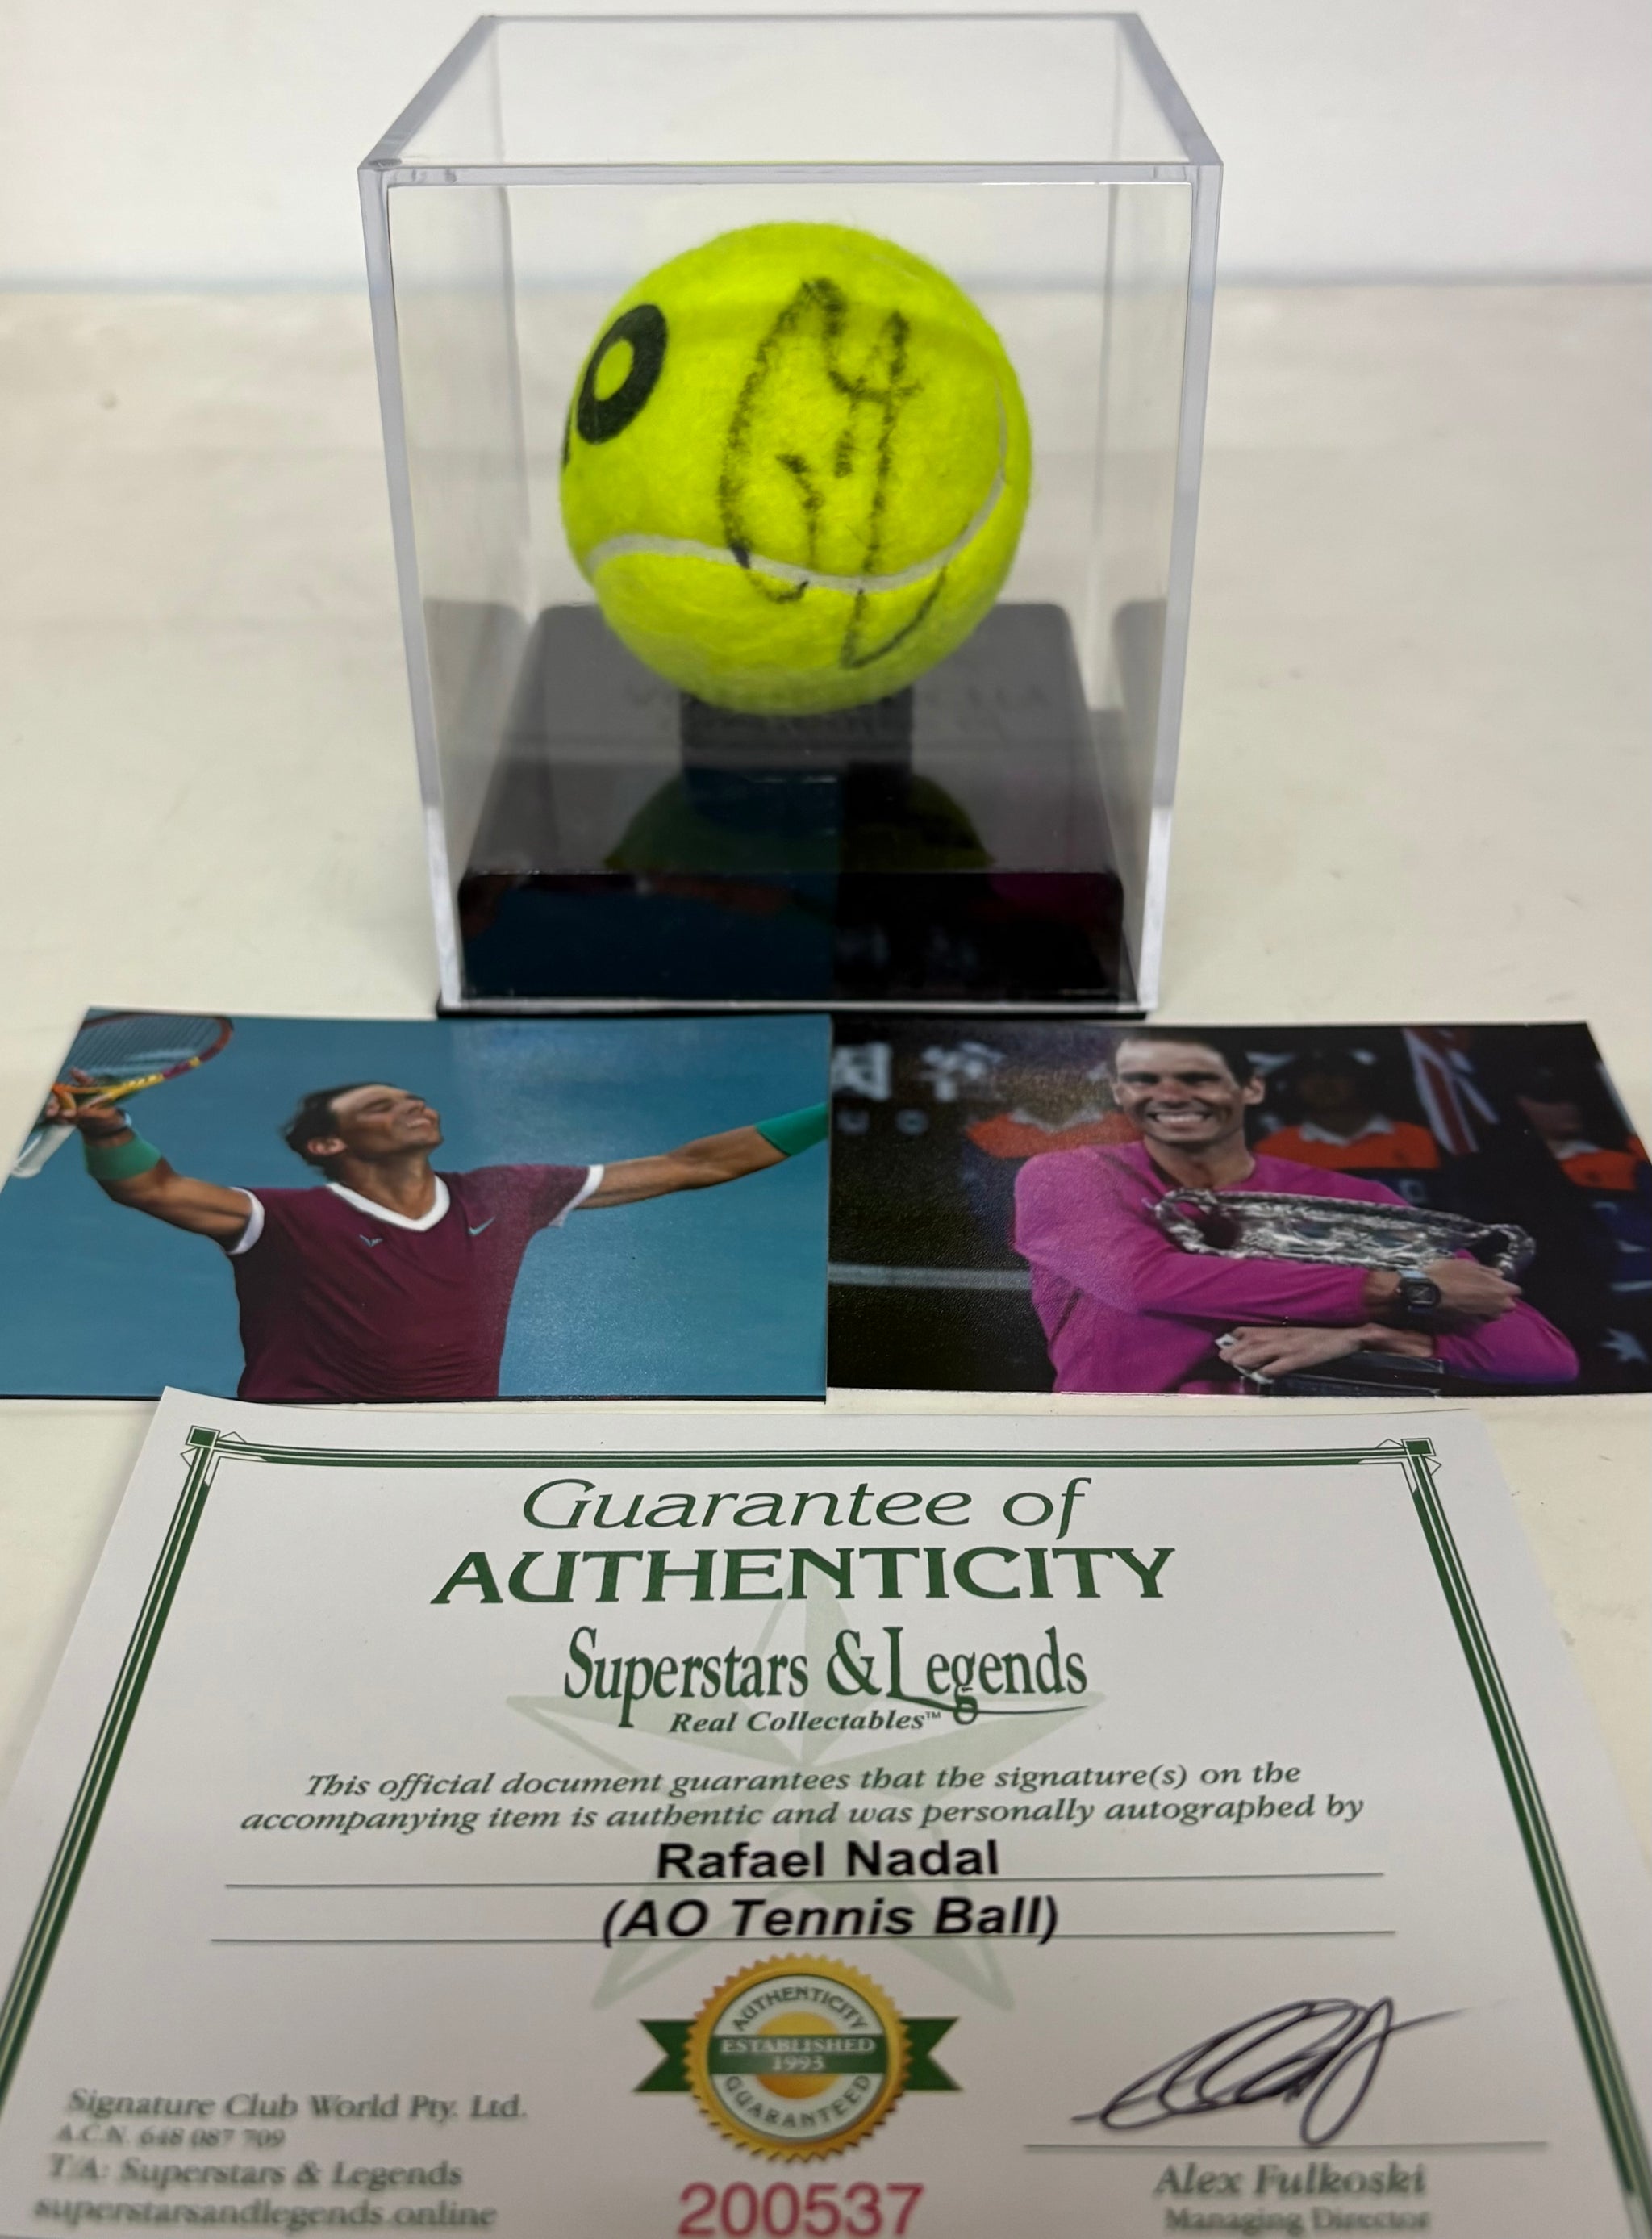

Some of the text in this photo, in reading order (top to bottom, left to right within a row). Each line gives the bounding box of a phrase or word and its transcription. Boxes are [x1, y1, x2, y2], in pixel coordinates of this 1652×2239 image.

[523, 1477, 1091, 1540] Guarantee of
[430, 1547, 1175, 1604] AUTHENTICITY
[565, 1625, 807, 1728] Superstars
[669, 1710, 735, 1734] Real
[305, 1762, 1301, 1802] This official document guarantees that the signature(s) on the
[241, 1794, 1365, 1836] accompanying item is authentic and was personally autographed by
[657, 1839, 999, 1878] Rafael Nadal
[602, 1895, 1059, 1948] (AO Tennis Ball)
[732, 1985, 870, 2032] AUTHENTICITY
[721, 2038, 876, 2053] ESTABLISHED
[68, 2091, 528, 2120] Signature Club World Pty. Ltd.
[725, 2074, 873, 2129] GUARANTEED
[119, 2156, 286, 2190] Superstars
[294, 2160, 321, 2185] &
[331, 2161, 462, 2191] Legends
[1153, 2161, 1427, 2196] Alex Fulkoski
[678, 2180, 926, 2238] 200537
